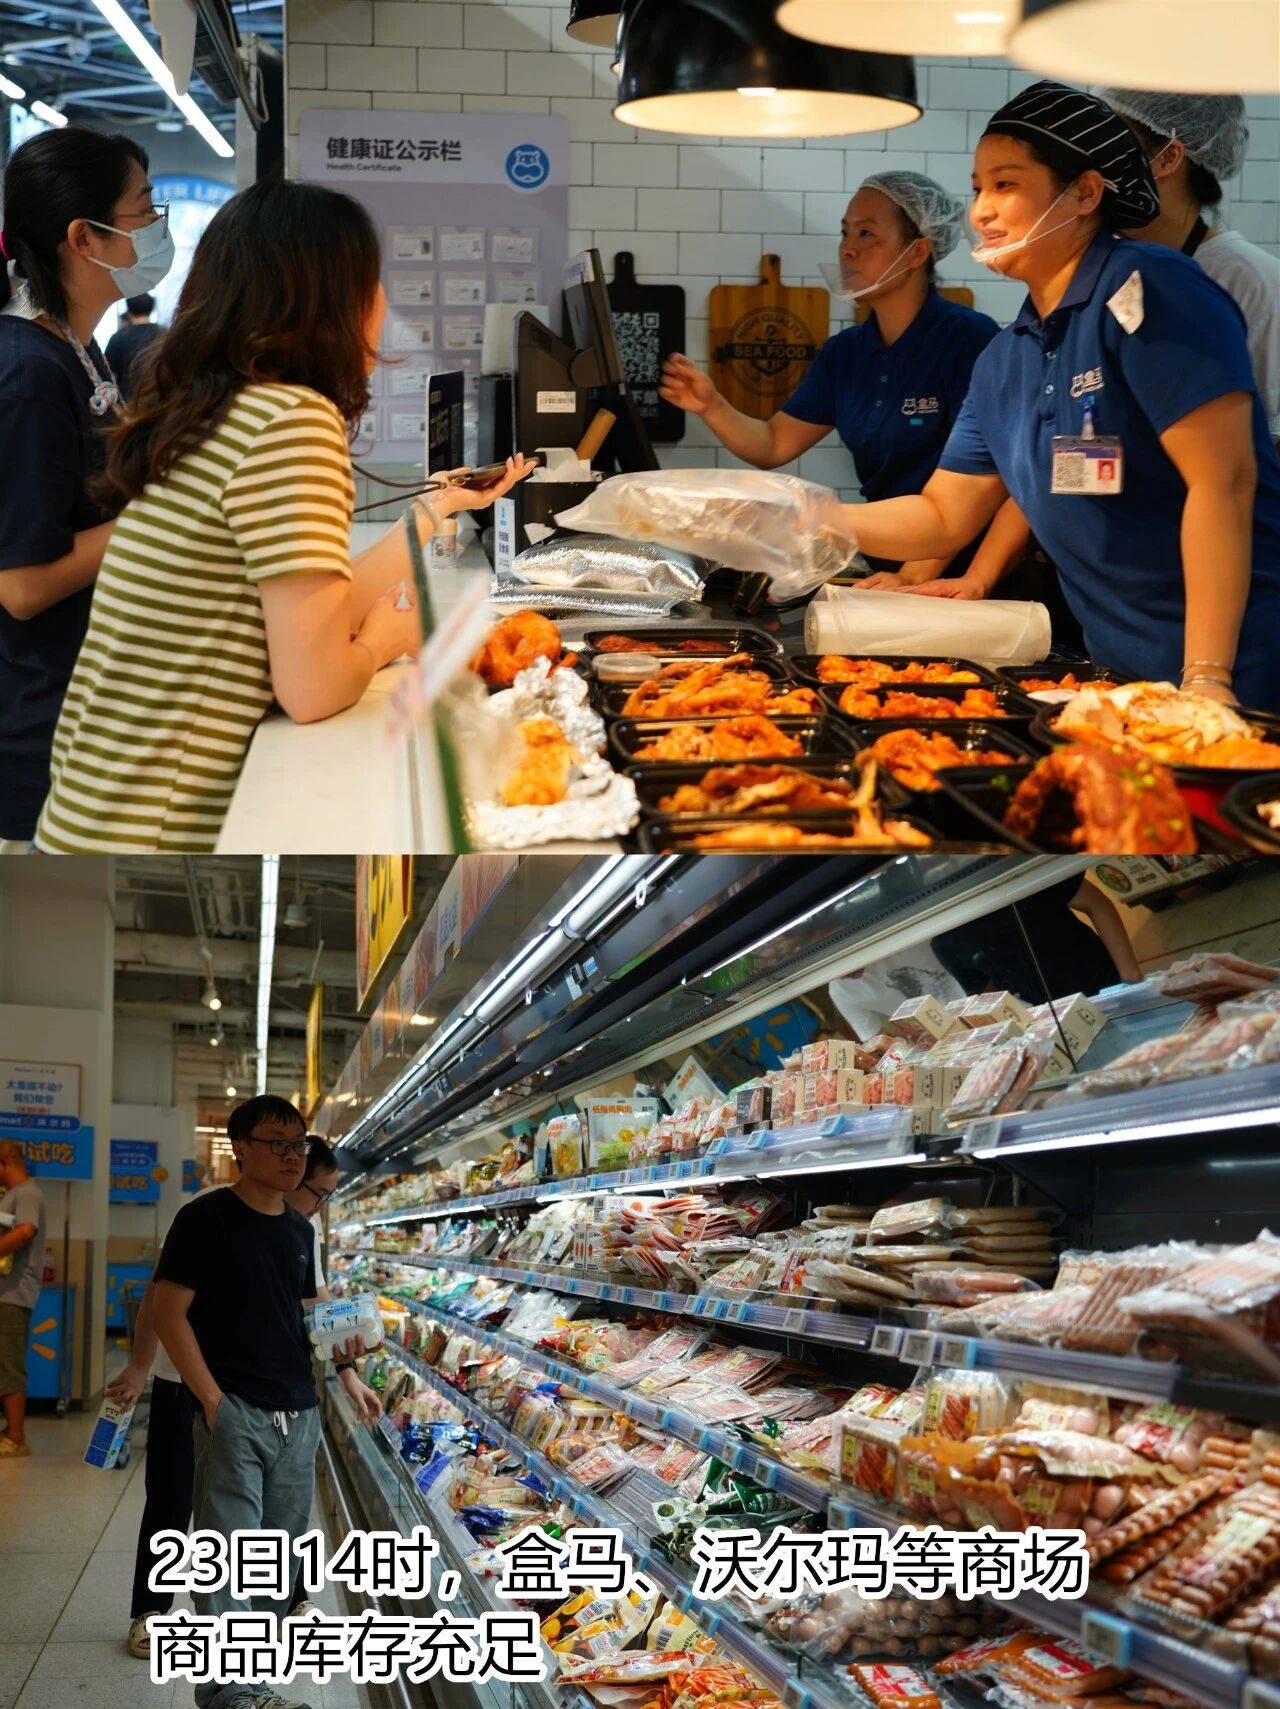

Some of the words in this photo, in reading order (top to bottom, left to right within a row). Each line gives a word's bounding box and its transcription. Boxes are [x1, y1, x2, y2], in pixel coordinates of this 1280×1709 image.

[326, 137, 462, 162] 健康证公示栏
[326, 163, 355, 171] Health
[357, 163, 403, 172] Certificate
[734, 345, 762, 357] SEA
[767, 346, 807, 358] FOOD
